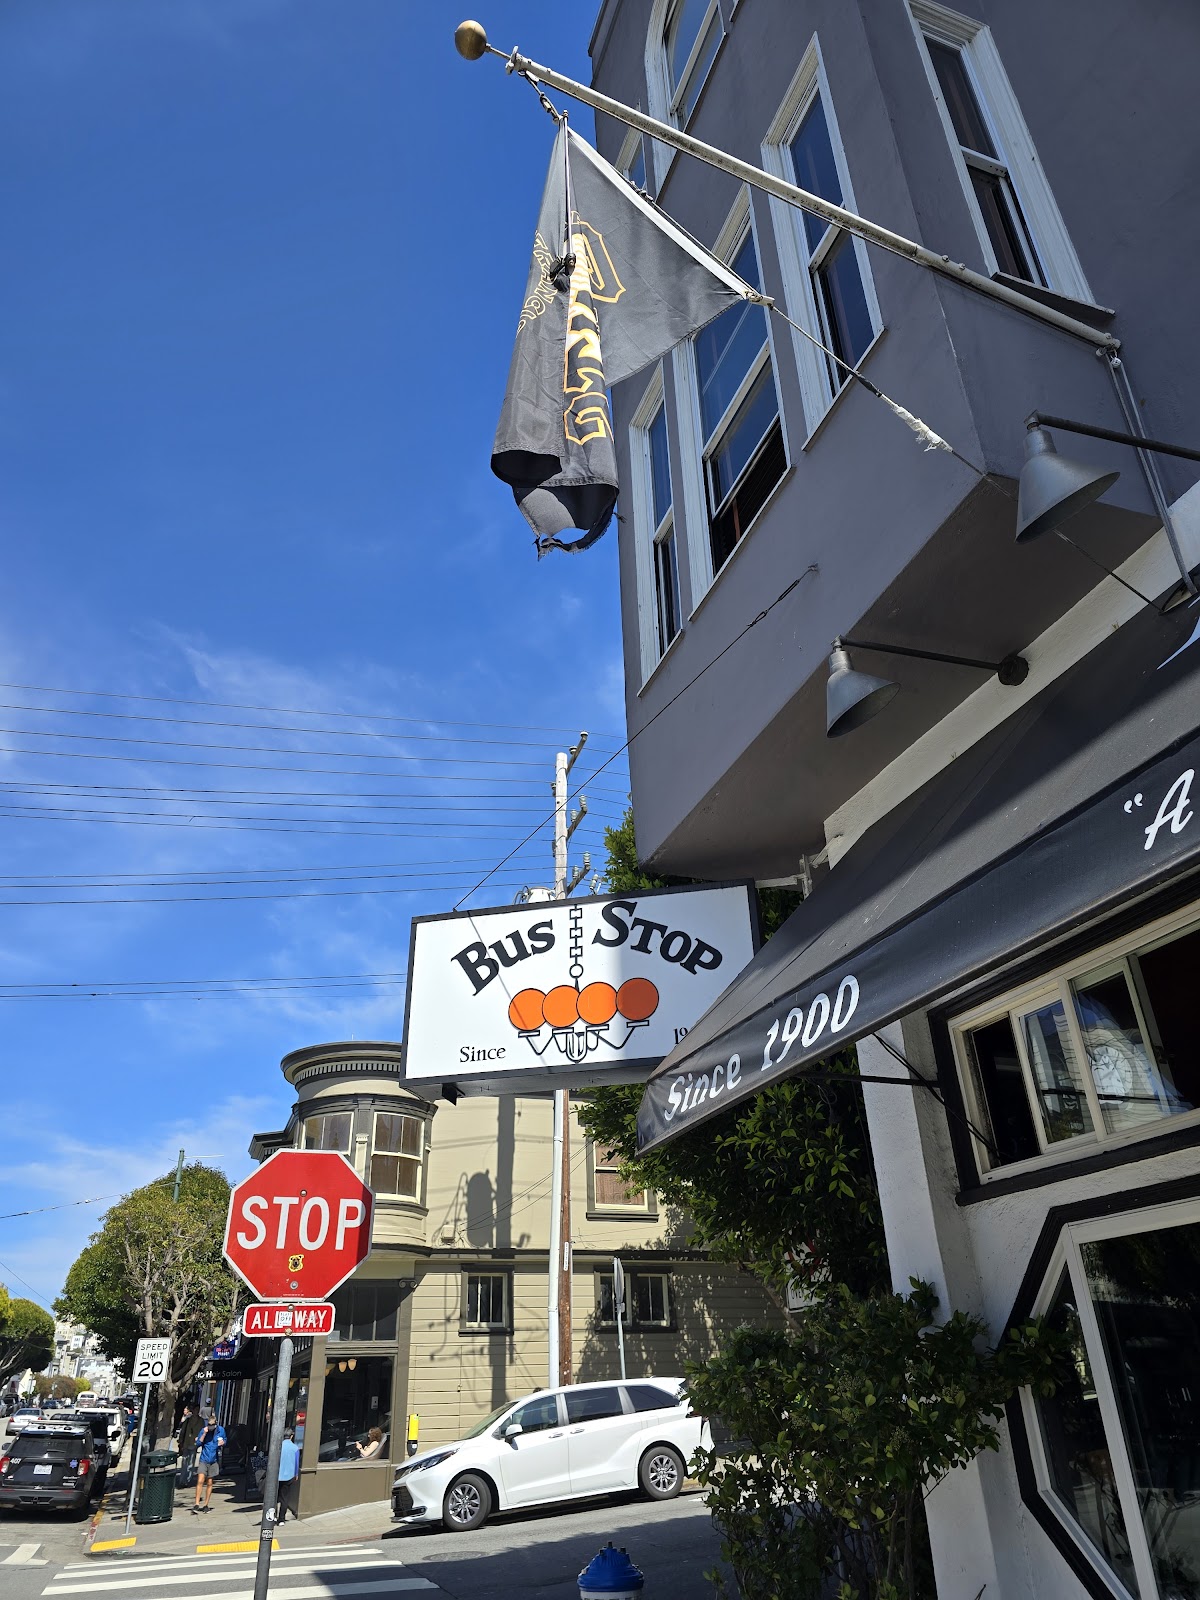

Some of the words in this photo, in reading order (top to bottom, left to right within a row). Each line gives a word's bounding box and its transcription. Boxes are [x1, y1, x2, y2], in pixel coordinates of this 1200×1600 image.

[459, 1046, 507, 1063] Since
[673, 1026, 689, 1045] 19
[664, 1053, 742, 1121] Since
[760, 975, 860, 1071] 1900
[236, 1195, 367, 1251] STOP
[294, 1309, 328, 1329] WAY
[140, 1343, 168, 1351] SPEED
[142, 1351, 164, 1360] LIMIT
[137, 1361, 164, 1377] 20
[221, 1370, 243, 1378] Salon
